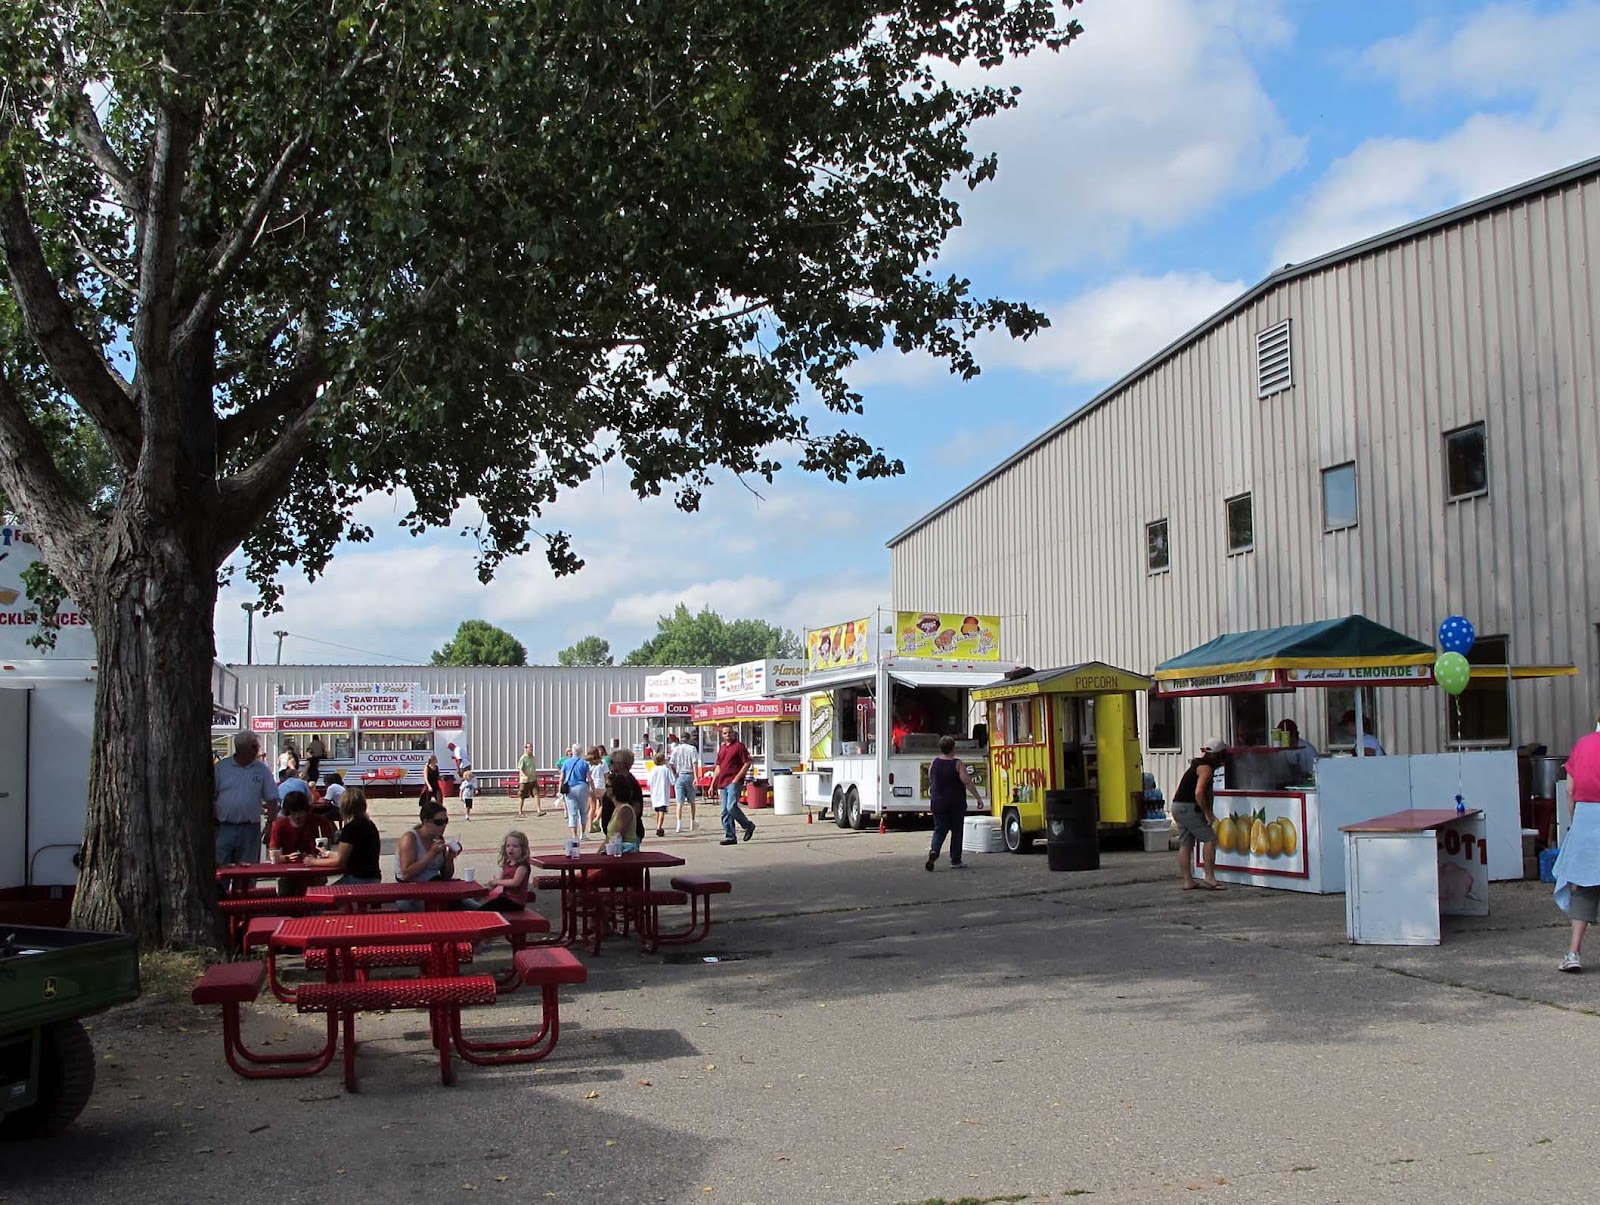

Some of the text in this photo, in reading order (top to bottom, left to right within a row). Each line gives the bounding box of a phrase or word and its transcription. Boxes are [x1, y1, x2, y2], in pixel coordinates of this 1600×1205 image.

[1304, 666, 1413, 679] Hand made LEMONADE
[775, 679, 799, 687] Serves
[1076, 676, 1118, 689] POPCORN
[1173, 672, 1256, 689] Fresh Squeezed Lemonade
[344, 695, 400, 703] STRAWBERRY
[616, 704, 659, 714] FUNNEL CAKES
[667, 704, 689, 713] COLD
[736, 703, 779, 713] COLD DRINKS
[255, 721, 275, 729] COFFEE
[283, 720, 348, 728] CARAMEL APPLES
[363, 719, 430, 728] APPLE DUMPLINGS
[437, 719, 460, 727] COFFEE
[994, 750, 1016, 771] POP
